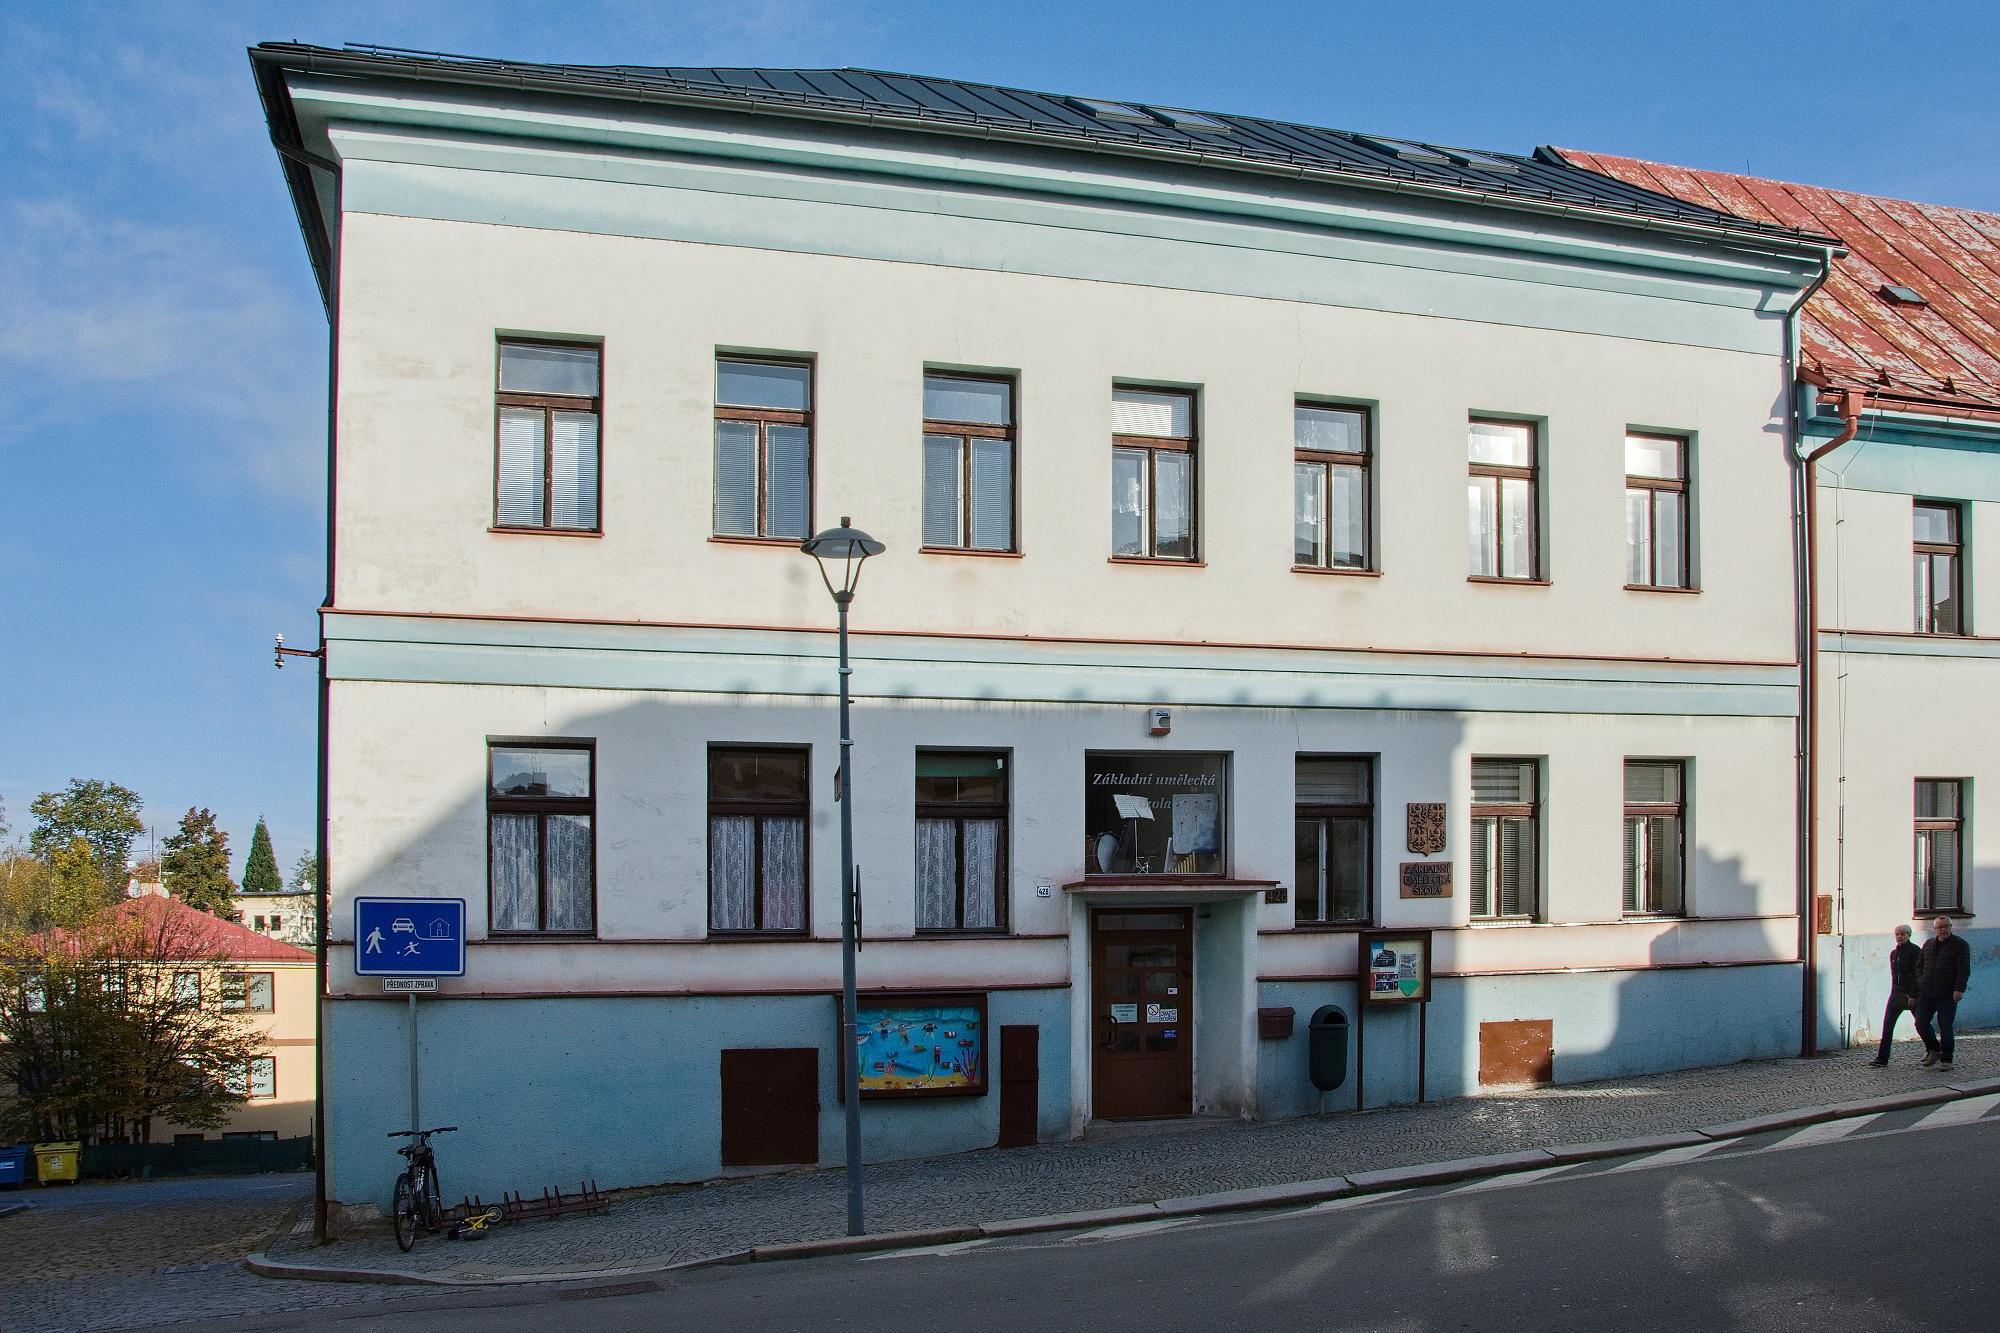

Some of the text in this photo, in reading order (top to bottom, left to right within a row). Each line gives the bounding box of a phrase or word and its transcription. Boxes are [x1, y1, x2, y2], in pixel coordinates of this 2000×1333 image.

[1092, 773, 1216, 786] Základní umělecká
[386, 979, 434, 989] PŘEDNOST ZPRAVA
